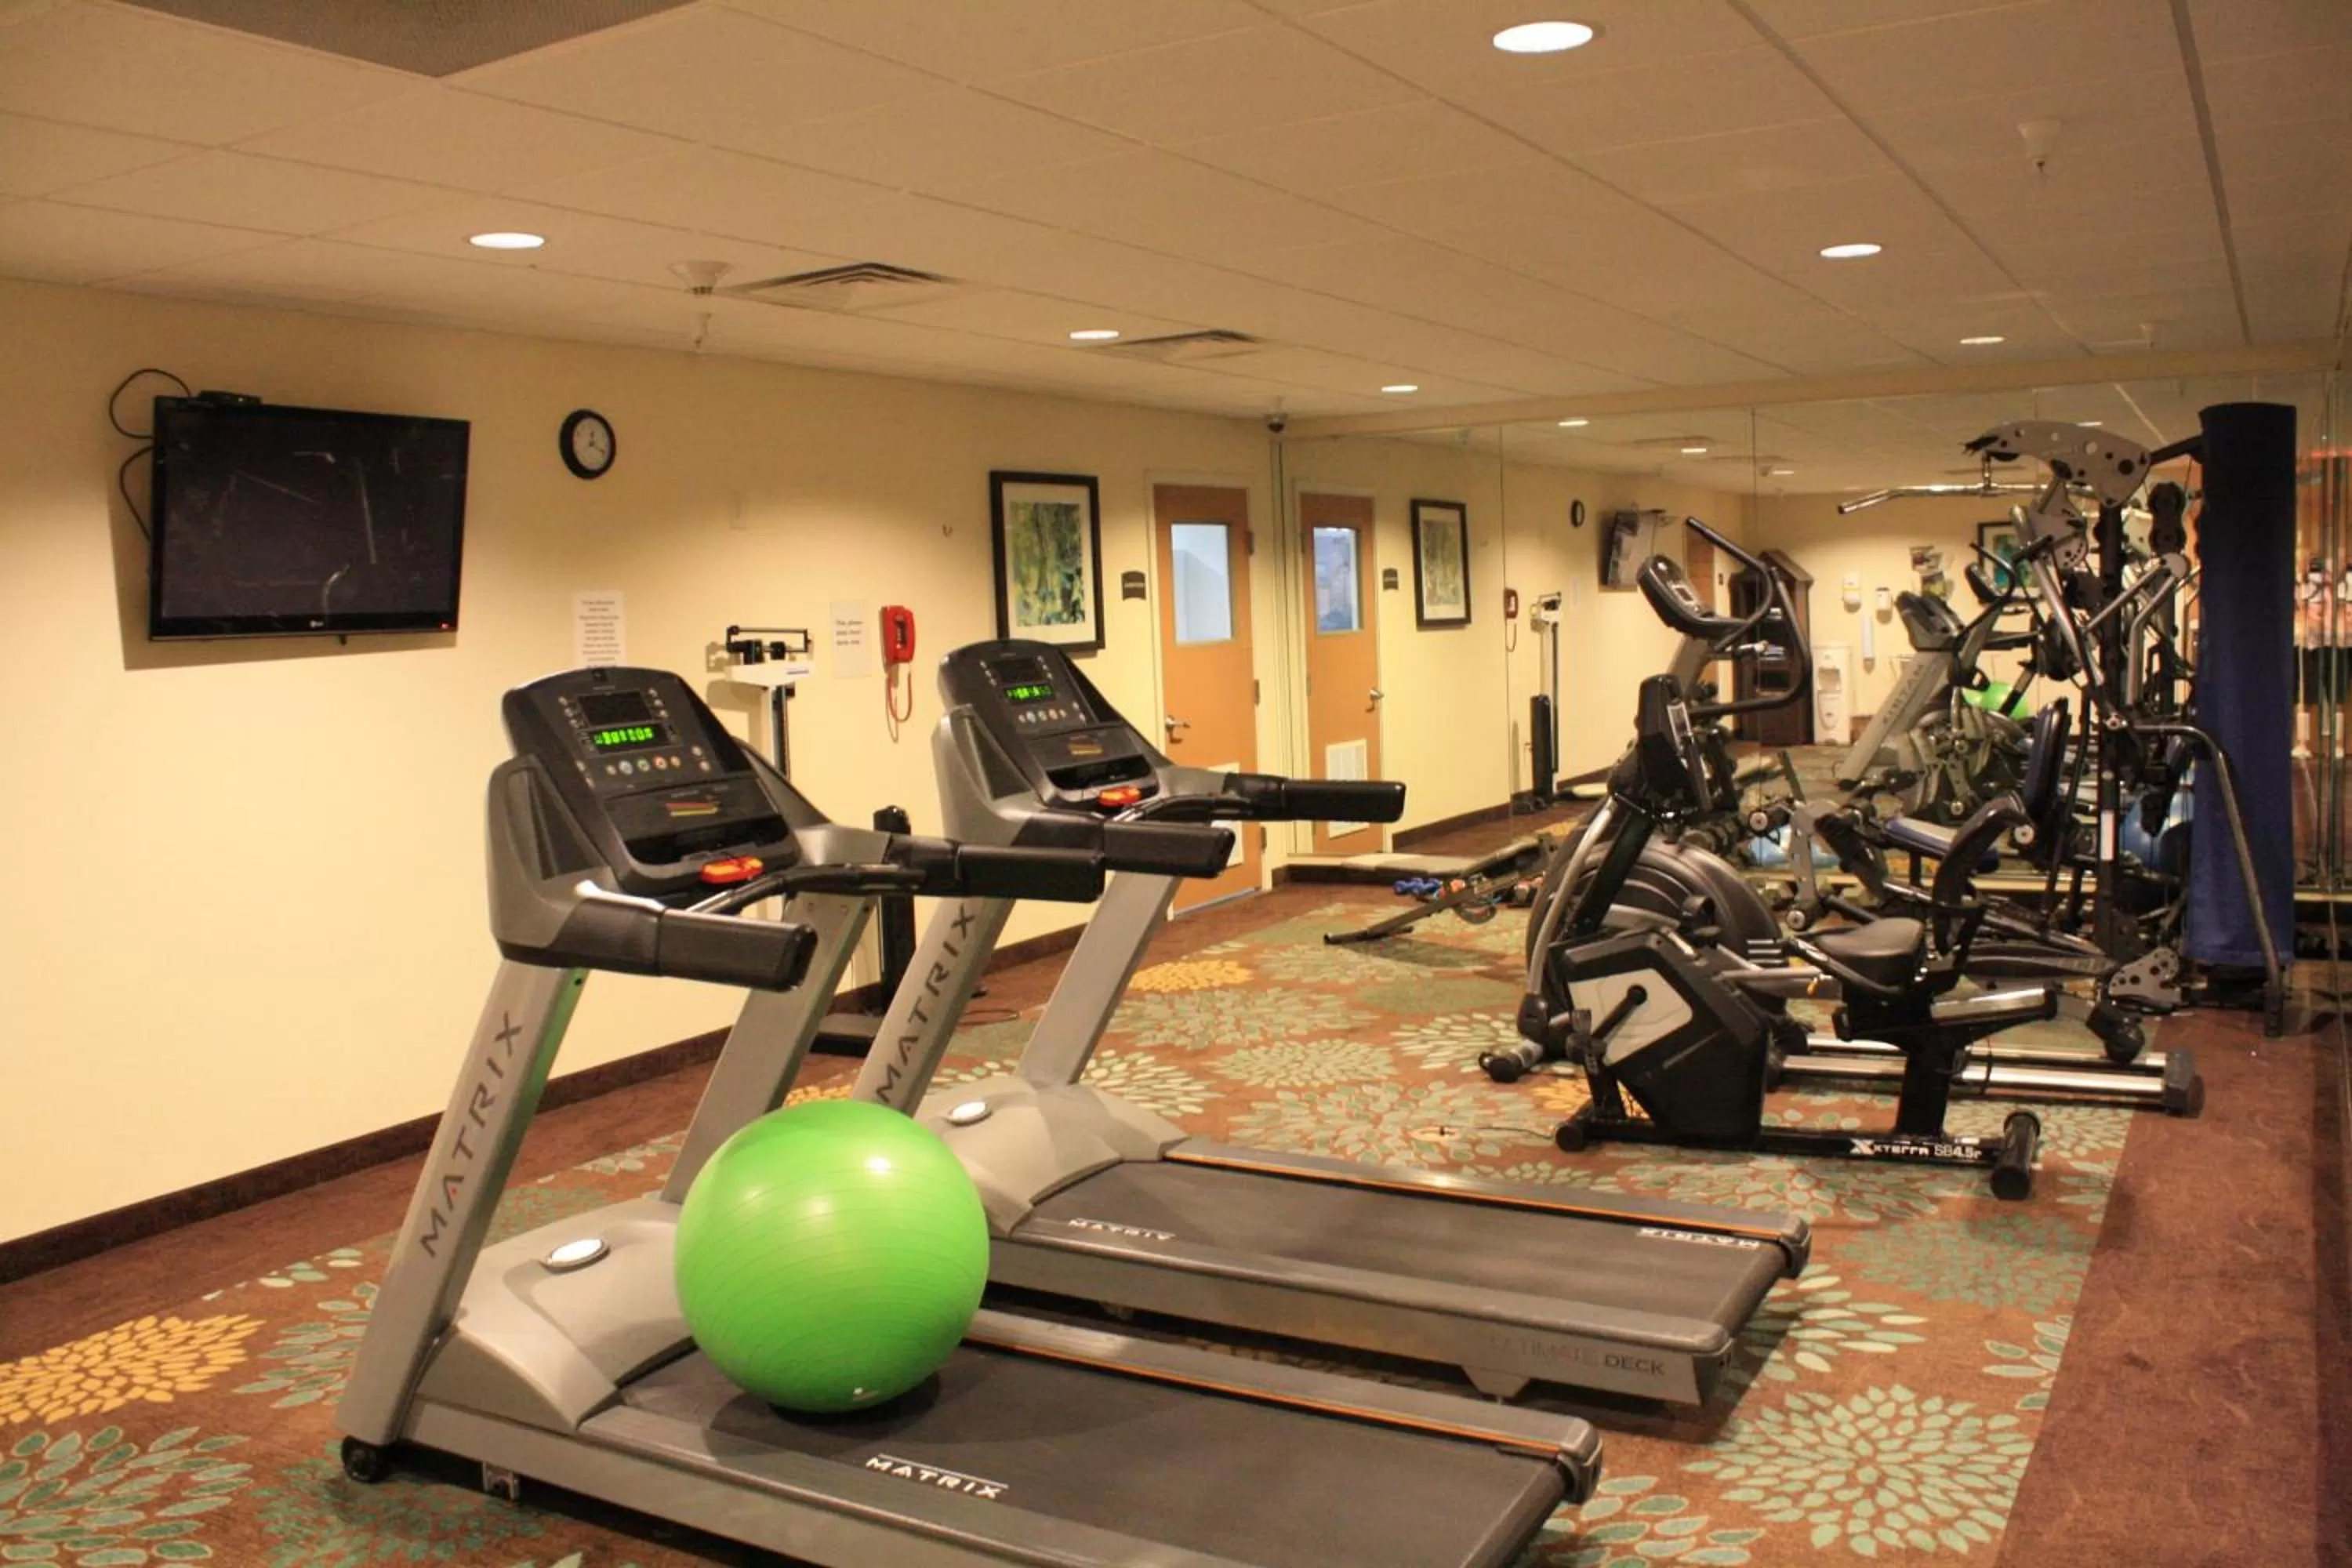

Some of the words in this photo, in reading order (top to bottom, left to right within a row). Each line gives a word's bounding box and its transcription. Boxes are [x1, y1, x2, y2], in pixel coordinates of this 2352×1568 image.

[876, 903, 975, 1102] MATRIX
[419, 1011, 522, 1258] MATRIX
[1605, 1354, 1664, 1376] DECK
[866, 1457, 993, 1499] MATRIX
